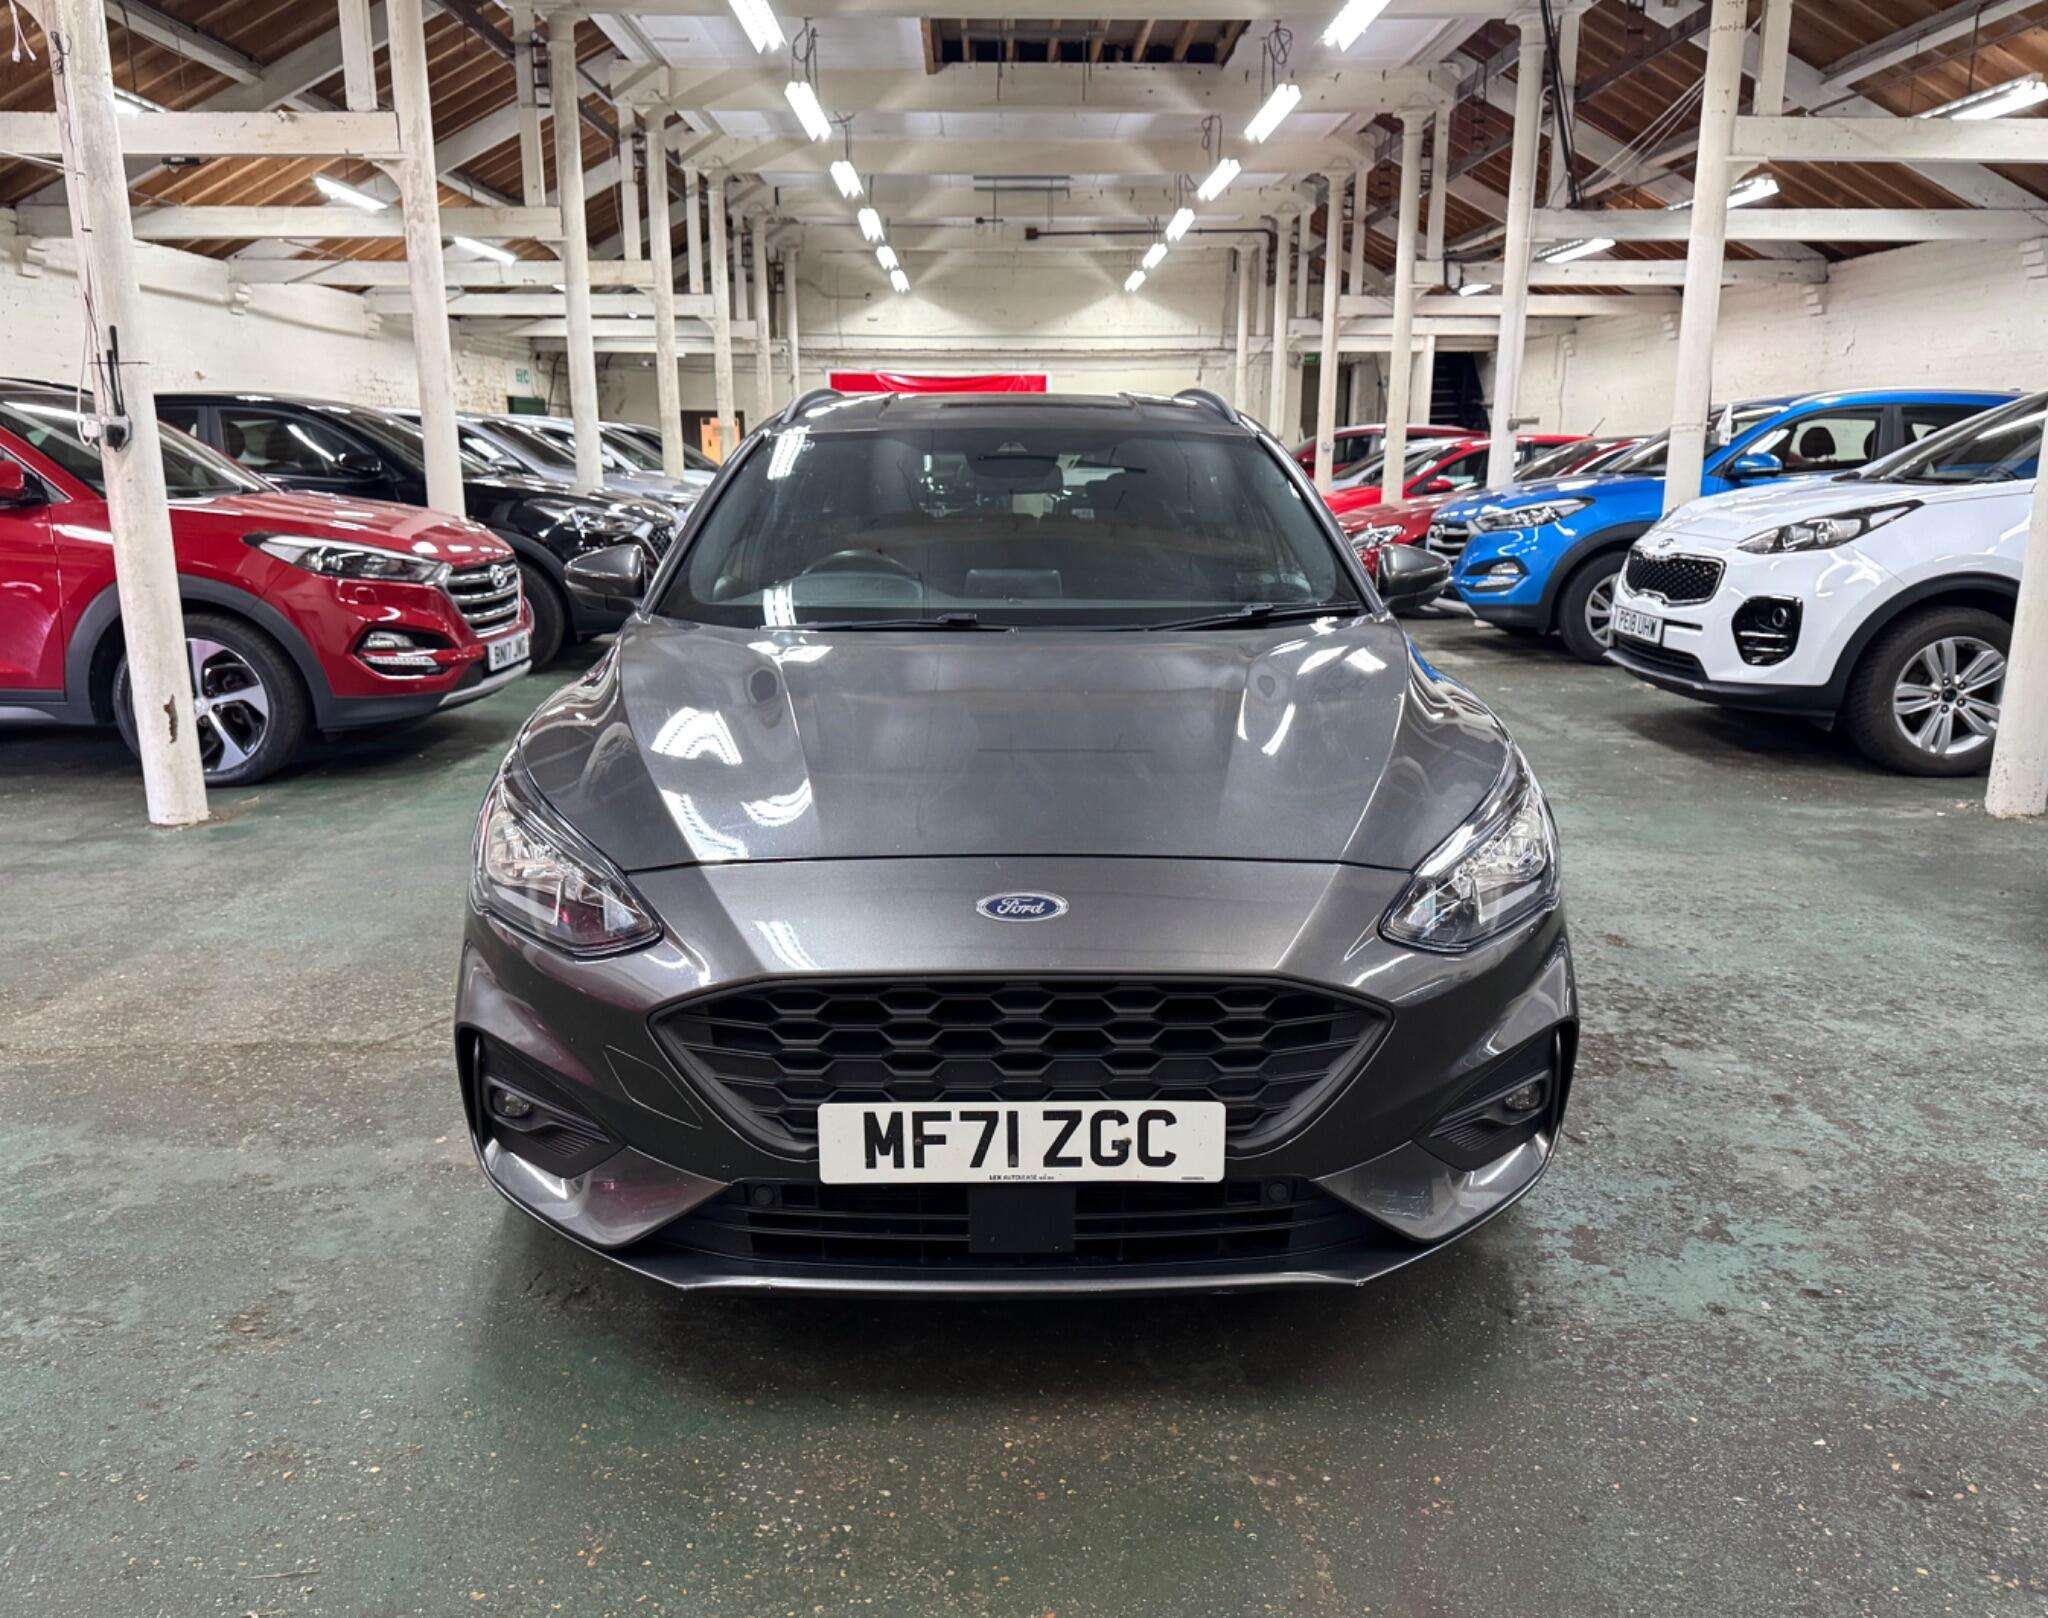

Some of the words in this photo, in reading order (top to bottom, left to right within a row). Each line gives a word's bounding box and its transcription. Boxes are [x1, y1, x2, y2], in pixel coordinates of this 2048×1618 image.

[997, 898, 1045, 914] Ford
[863, 1111, 1019, 1169] MF71
[1043, 1109, 1177, 1168] ZGC
